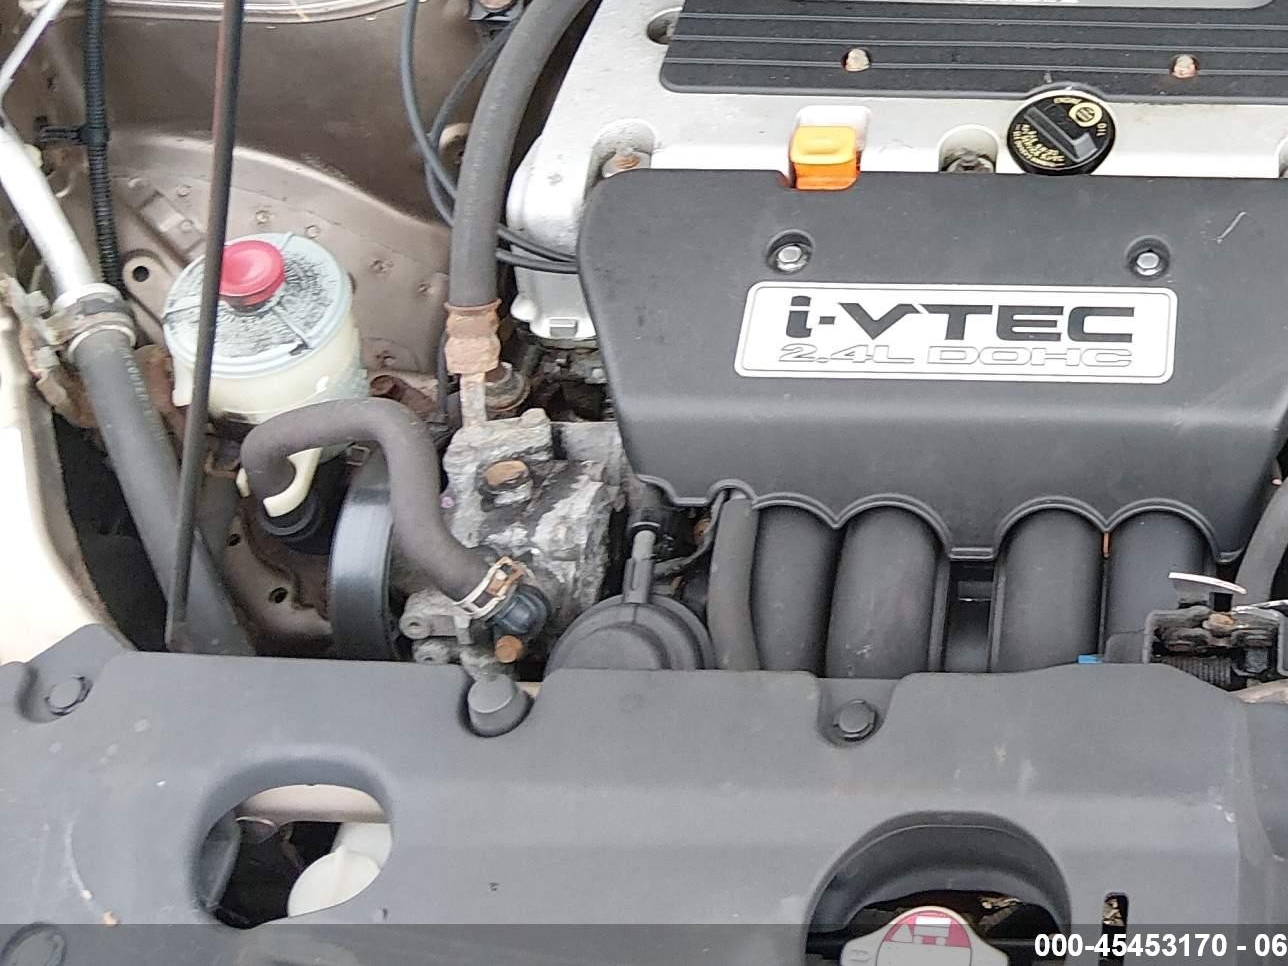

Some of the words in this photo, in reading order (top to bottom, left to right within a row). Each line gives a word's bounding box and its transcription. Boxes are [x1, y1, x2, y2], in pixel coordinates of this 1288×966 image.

[786, 295, 1135, 342] i-VTEC
[779, 343, 914, 365] 2.4L
[927, 346, 1132, 368] DOHC
